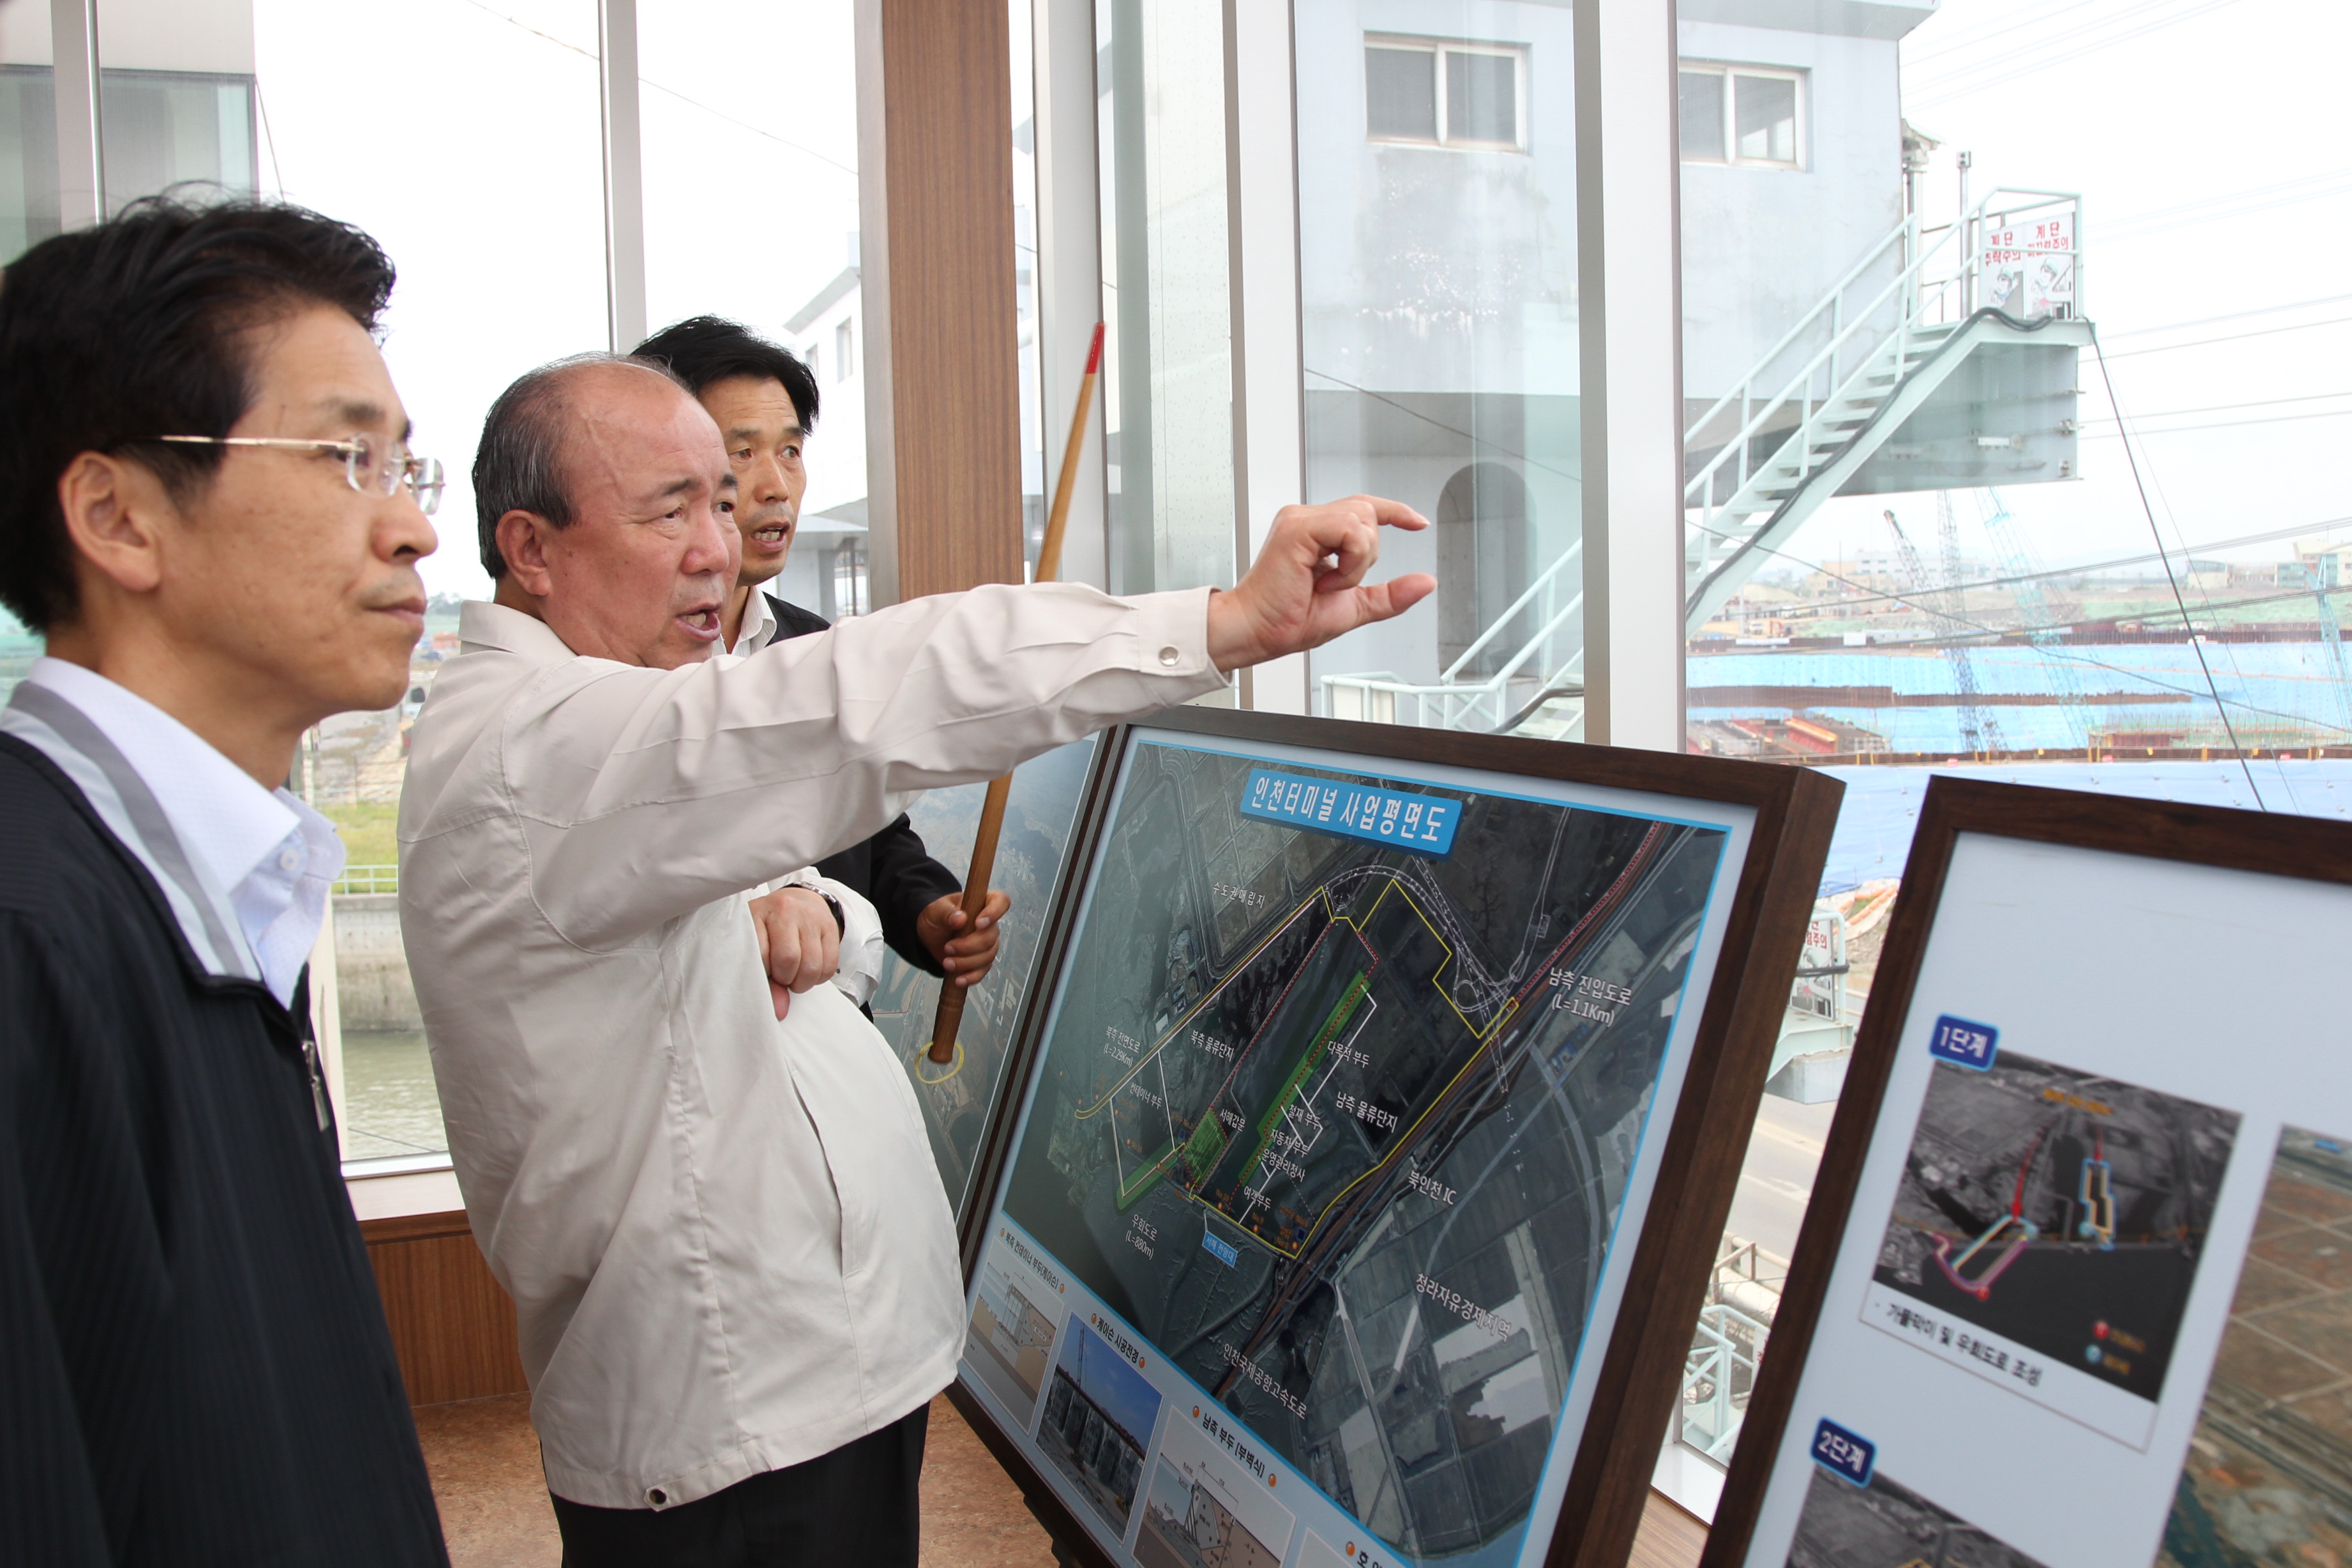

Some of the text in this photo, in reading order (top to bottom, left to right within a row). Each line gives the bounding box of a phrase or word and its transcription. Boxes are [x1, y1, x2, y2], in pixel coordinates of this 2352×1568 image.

[1251, 777, 1446, 842] 인천터미널 사업평면도
[1212, 881, 1265, 909] 수도권매립지
[1549, 967, 1632, 1006] 남측 진입도로
[1105, 1026, 1141, 1054] 북측 전면도로
[1191, 1030, 1234, 1062] 북측 물류단지
[1327, 1040, 1370, 1068] 다목적 부두
[1939, 1025, 1988, 1058] 1단계
[1130, 1082, 1151, 1103] 컨테이너
[1151, 1095, 1163, 1110] 부두
[1336, 1091, 1398, 1133] 남측 물류단지
[1219, 1108, 1246, 1132] 서해갑문
[1303, 1112, 1322, 1130] 부두
[1269, 1128, 1309, 1157] 자동차 부두
[1261, 1149, 1306, 1183] 운영관리청사
[1408, 1170, 1457, 1205] 북인천 IC
[1131, 1214, 1157, 1242] 우회도로
[1014, 1239, 1033, 1265] 컨테이너
[1205, 1235, 1236, 1263] 서해 전망대
[1416, 1273, 1512, 1343] 청라자유경제지역
[1097, 1316, 1140, 1366] 케이슨 시공전경
[1223, 1343, 1308, 1420] 인천국제공항고속도로
[1202, 1412, 1219, 1438] 남측
[1219, 1427, 1236, 1450] 부두
[1818, 1430, 1867, 1473] 2단계
